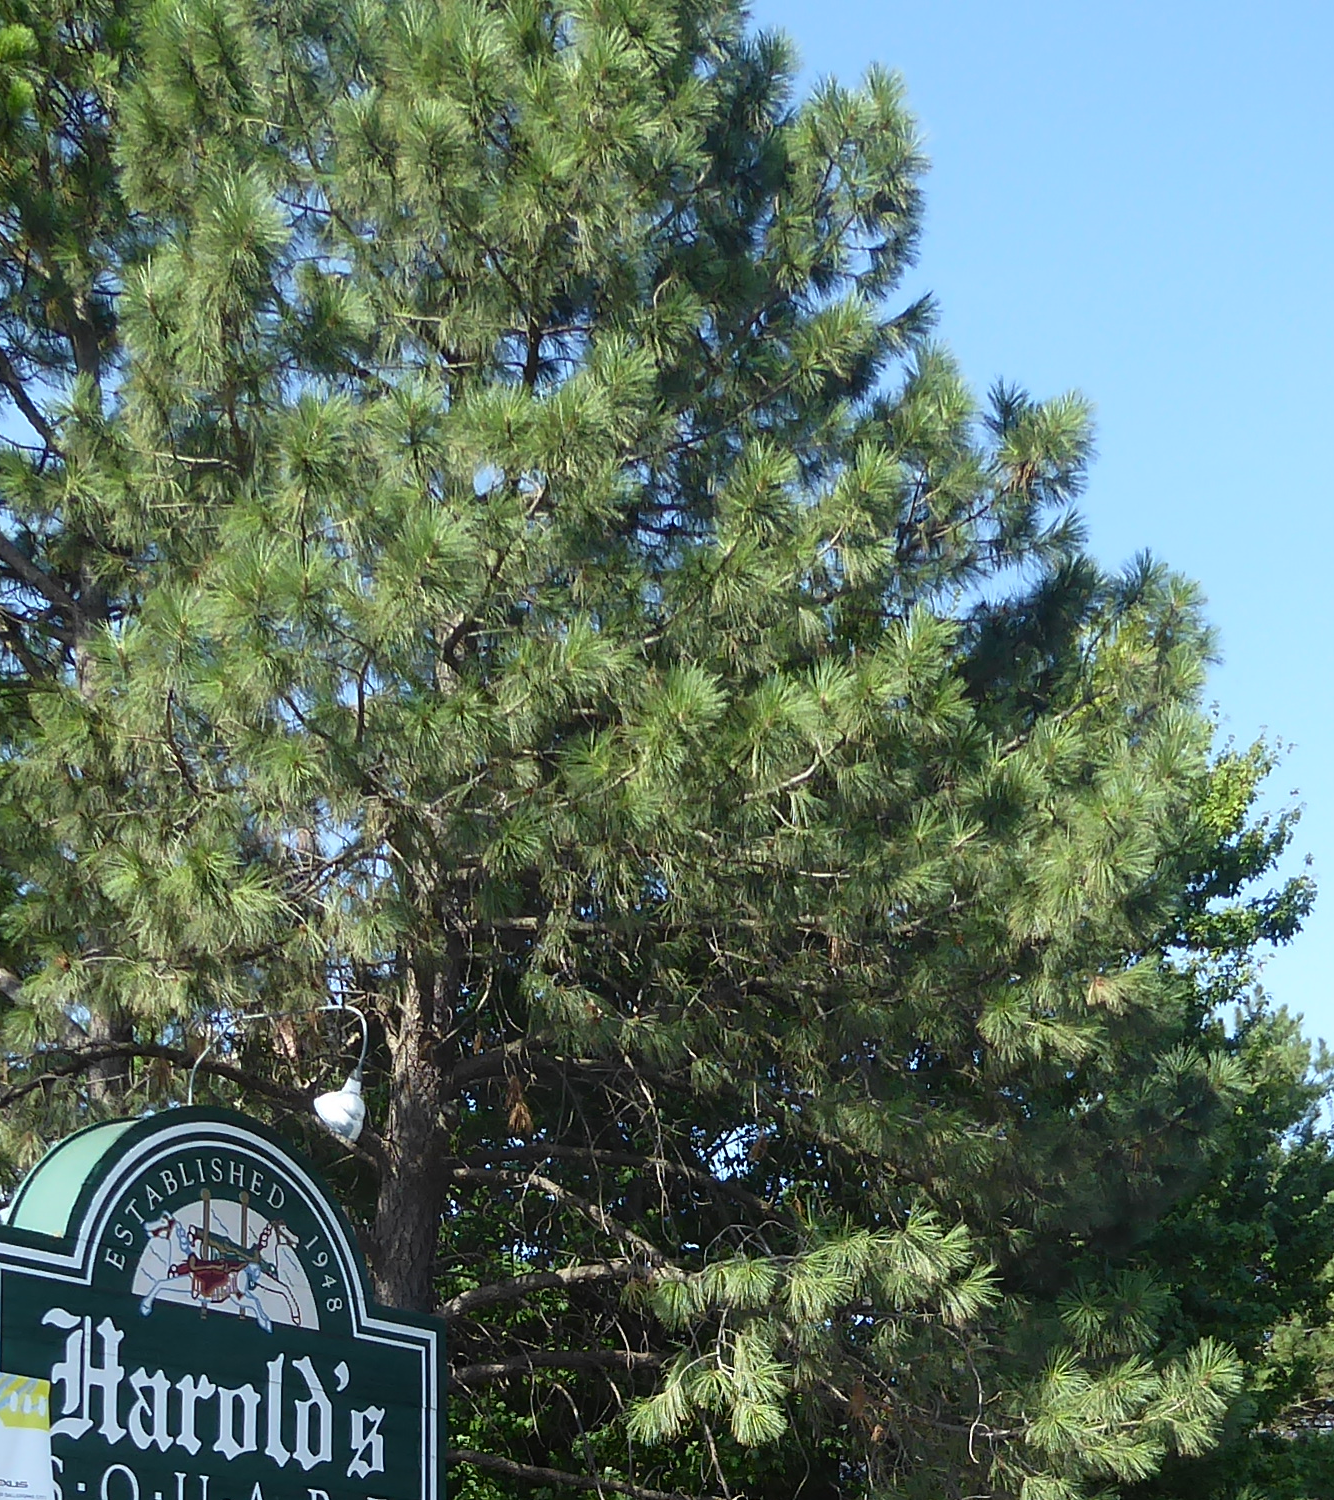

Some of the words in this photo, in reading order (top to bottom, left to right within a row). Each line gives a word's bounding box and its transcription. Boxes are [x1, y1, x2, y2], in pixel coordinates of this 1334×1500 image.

[104, 1157, 287, 1272] ESTABLISHED
[303, 1234, 344, 1313] 1948
[41, 1307, 386, 1479] Harold's
